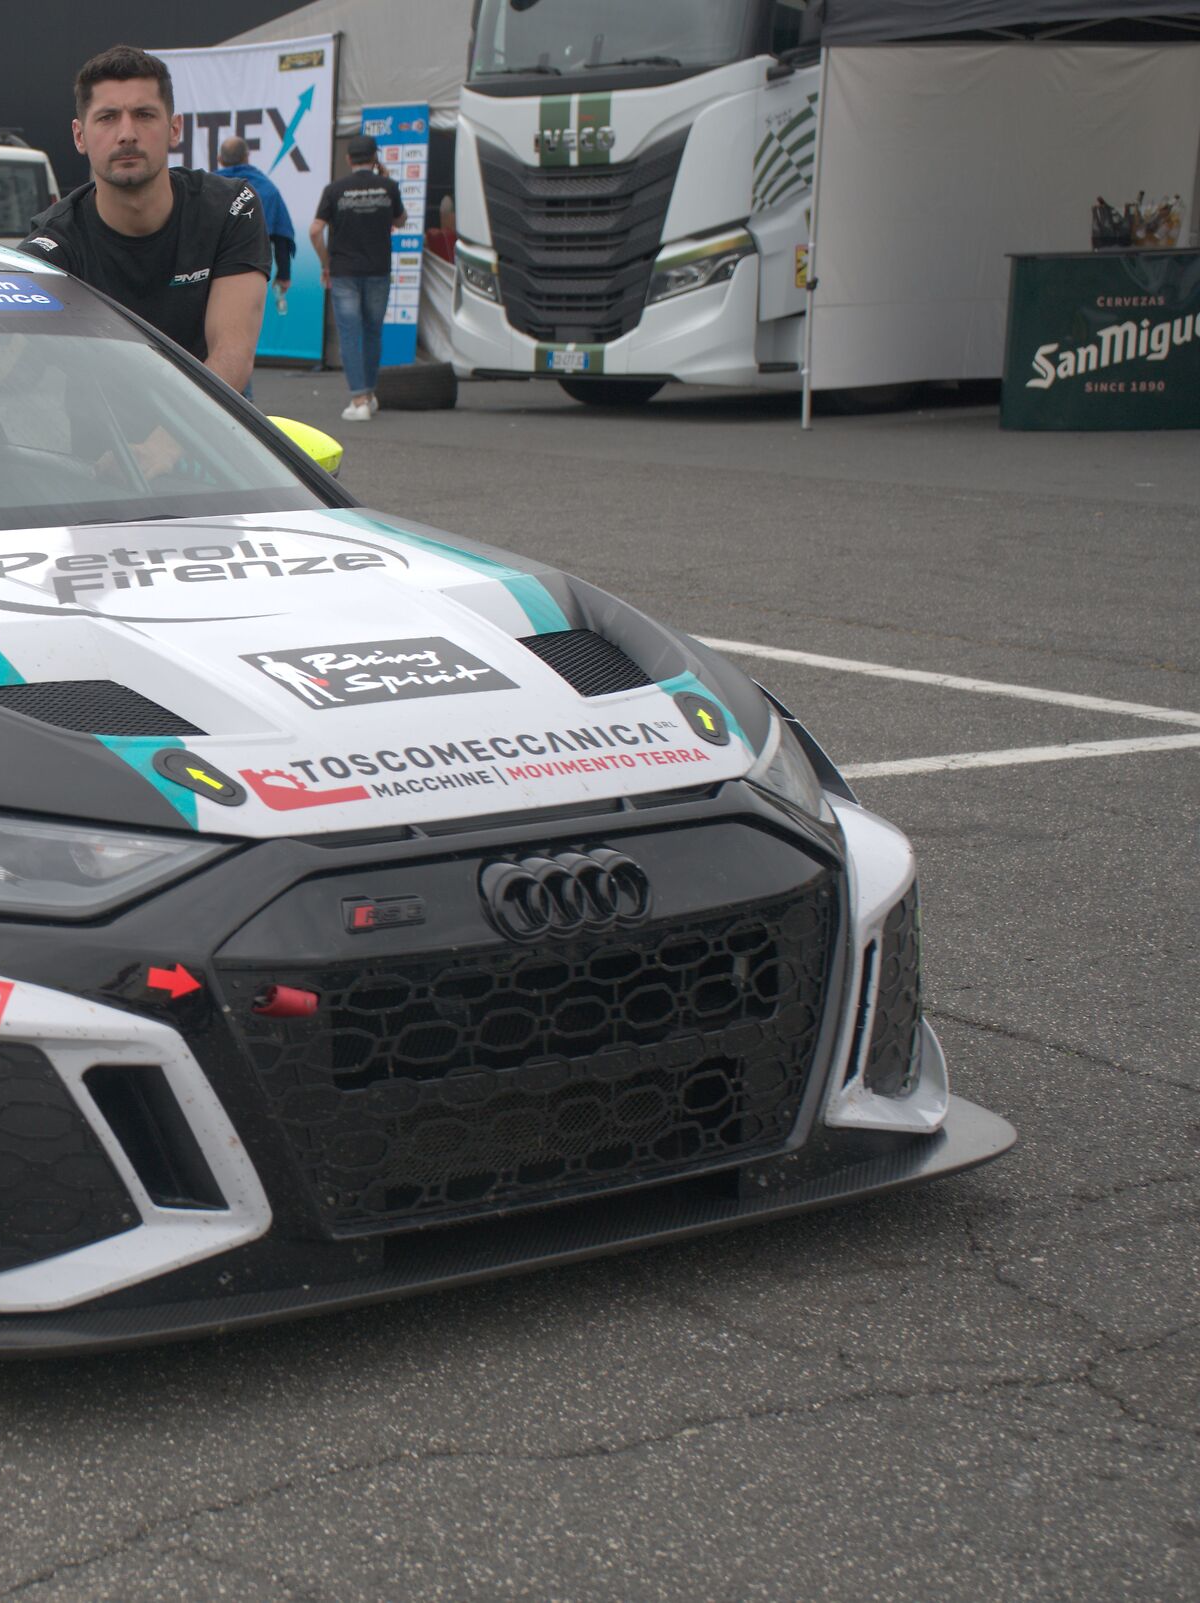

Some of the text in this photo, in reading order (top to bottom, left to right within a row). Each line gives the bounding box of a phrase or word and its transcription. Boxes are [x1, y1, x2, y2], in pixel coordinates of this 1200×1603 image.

[533, 126, 616, 153] IVECO
[1085, 381, 1166, 393] SINCE 1890
[52, 551, 387, 605] Firenze
[302, 649, 443, 677] Racing
[344, 666, 490, 694] Spirit
[290, 722, 670, 784] TOSCOMECCANICA
[370, 747, 711, 798] MACCHINE MOVIMENTO TERRA
